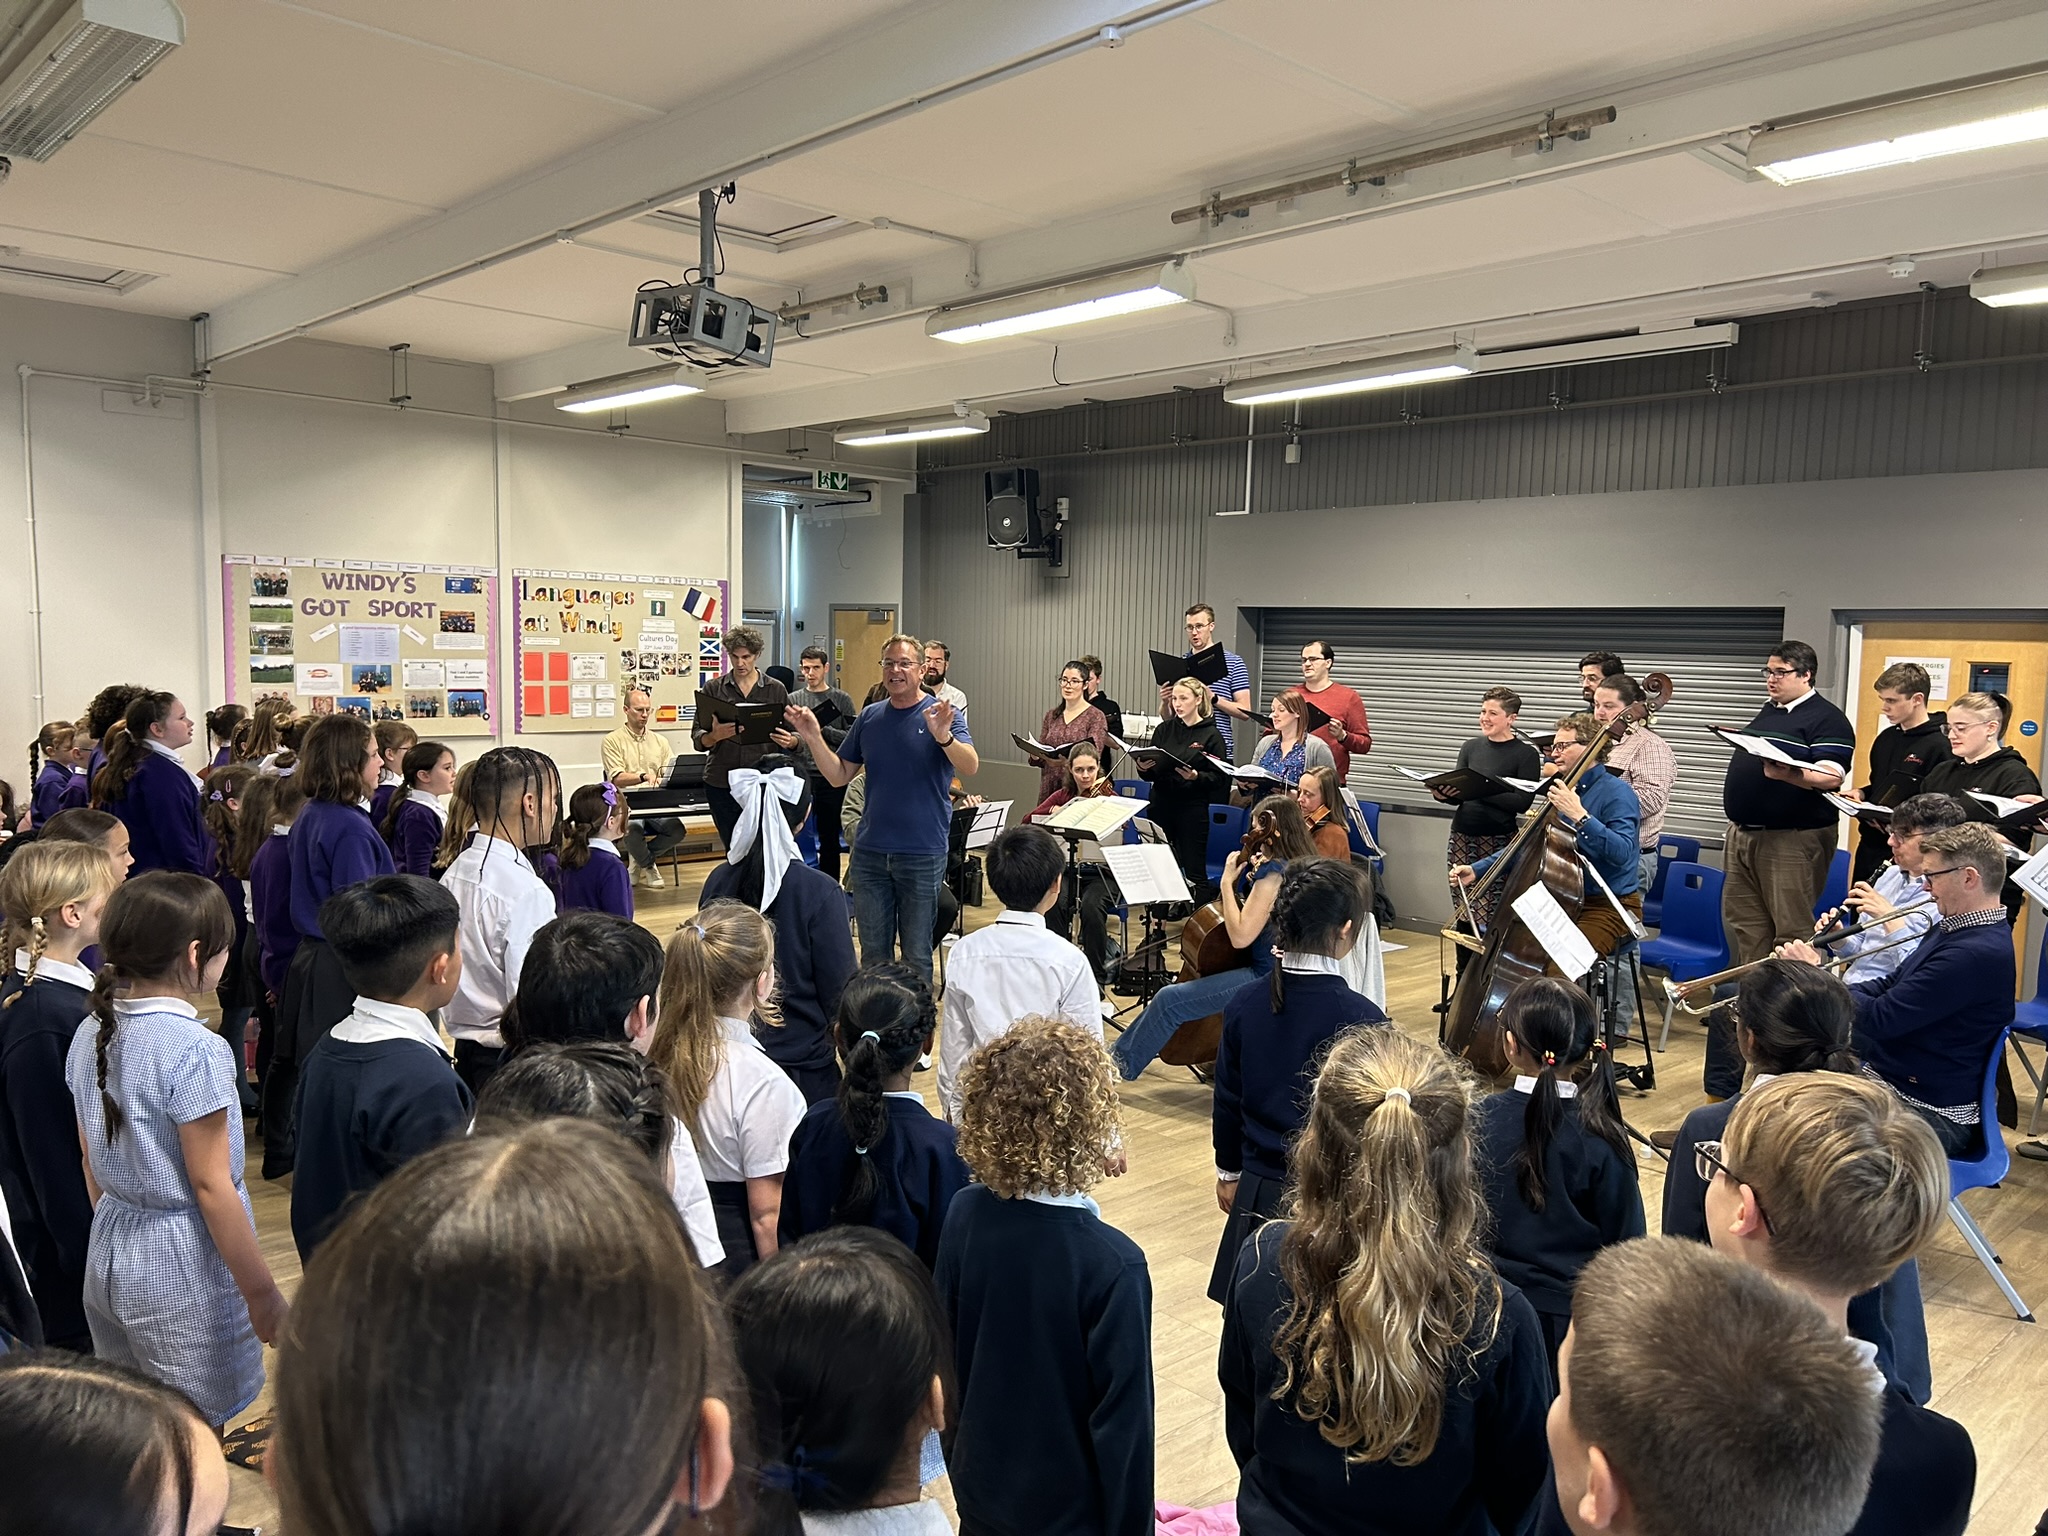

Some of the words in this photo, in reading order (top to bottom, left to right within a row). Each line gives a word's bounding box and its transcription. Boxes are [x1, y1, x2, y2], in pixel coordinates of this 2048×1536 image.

[321, 572, 417, 594] WINDY'S
[522, 579, 635, 612] Languages
[301, 598, 351, 617] GOT
[368, 599, 437, 619] SPORT
[524, 614, 550, 632] at
[559, 611, 623, 642] Windy
[639, 634, 664, 642] Cultures
[665, 635, 678, 644] Day
